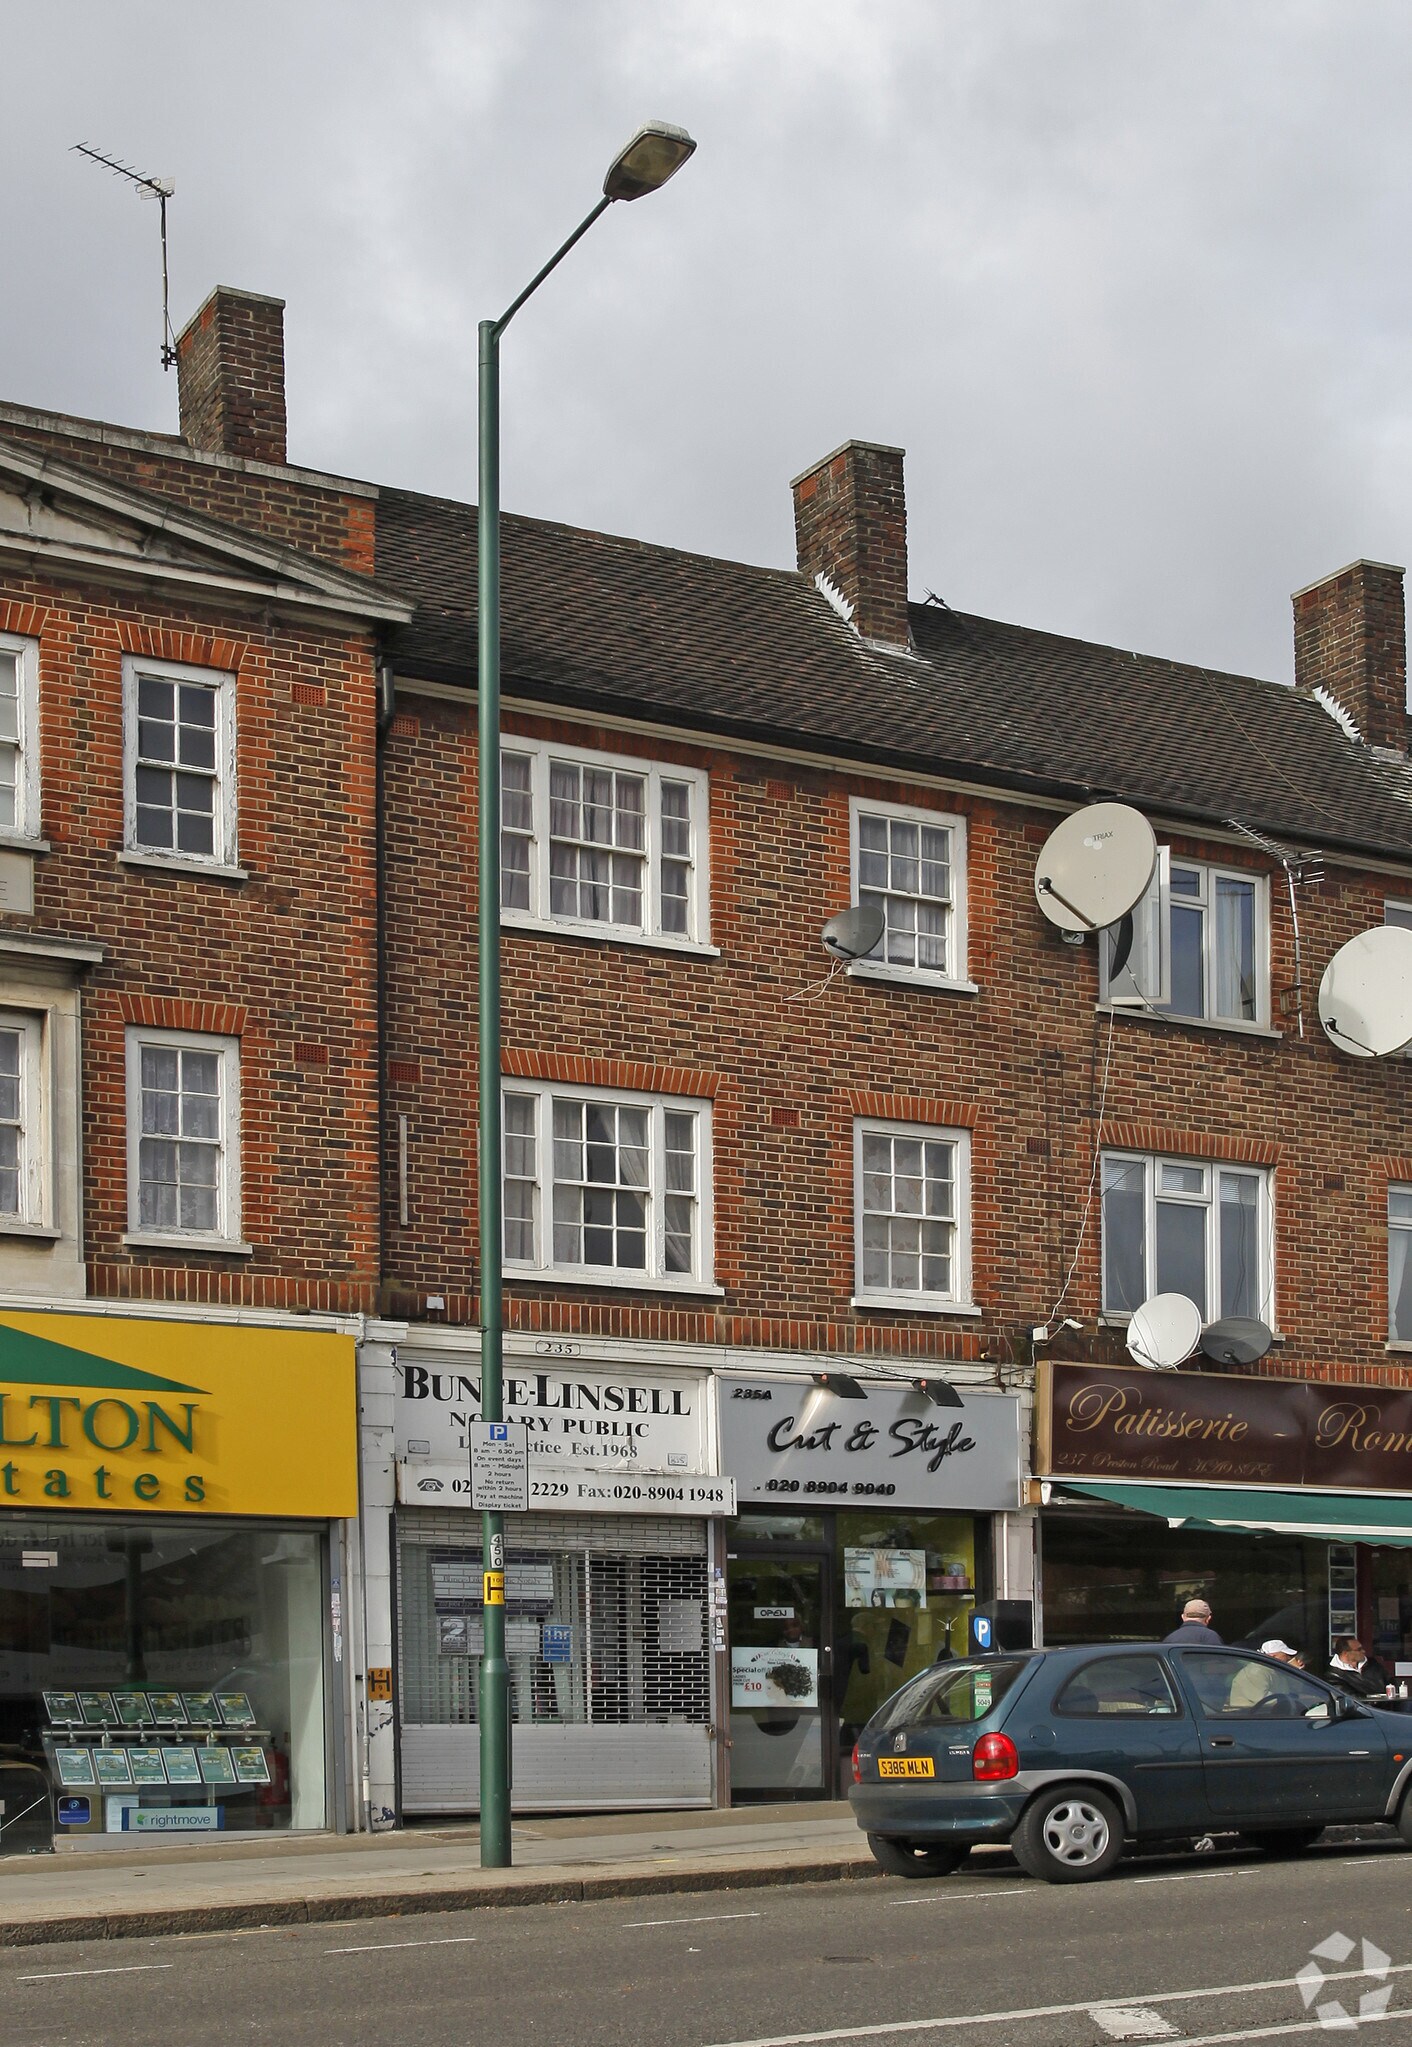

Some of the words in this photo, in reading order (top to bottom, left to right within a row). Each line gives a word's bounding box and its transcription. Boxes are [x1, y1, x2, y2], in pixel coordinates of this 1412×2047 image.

[1093, 831, 1114, 841] TRIAX
[544, 1342, 572, 1355] 235
[401, 1365, 691, 1416] BUNE-LINSELL
[732, 1387, 772, 1401] 235A
[1066, 1383, 1249, 1441] Patisserie
[493, 1425, 504, 1440] P
[562, 1418, 650, 1438] PUBLIC
[571, 1442, 638, 1458] Est.1968
[767, 1416, 842, 1453] Cut
[844, 1420, 880, 1452] &
[888, 1418, 977, 1473] Style
[498, 1462, 524, 1470] Midnight
[1056, 1452, 1087, 1466] 237
[1092, 1451, 1137, 1470] Preston
[1140, 1454, 1179, 1472] Road
[688, 1487, 724, 1502] 1948
[766, 1478, 800, 1492] 020
[803, 1480, 849, 1494] 8904
[852, 1481, 896, 1496] 9040
[498, 1492, 523, 1500] machine
[478, 1501, 501, 1509] Display
[760, 1609, 787, 1617] OPEN
[544, 1627, 569, 1640] 1hr
[978, 1620, 989, 1642] P
[732, 1666, 757, 1674] Special
[370, 1670, 390, 1692] H
[744, 1682, 762, 1691] £10
[881, 1761, 906, 1775] S386
[907, 1760, 930, 1775] MLN
[150, 1814, 211, 1828] rightmove
